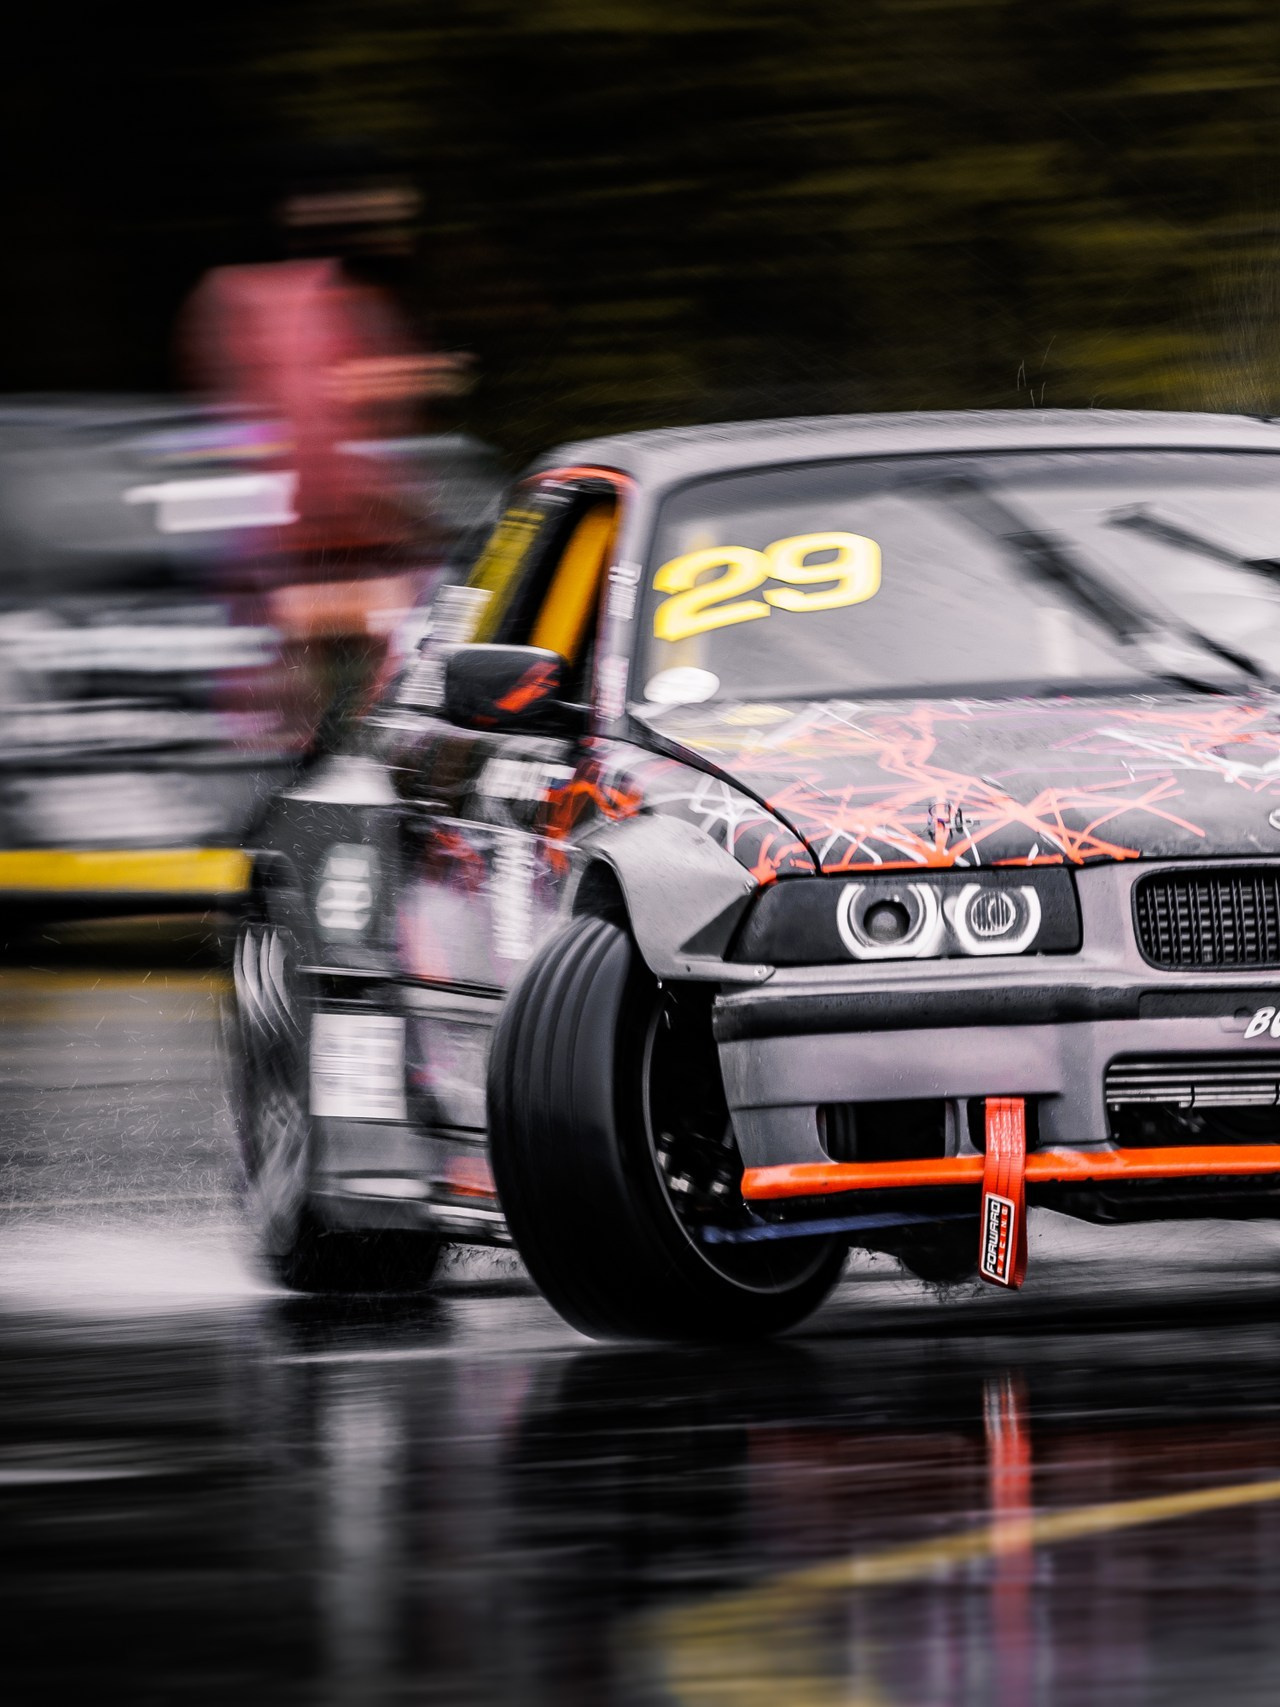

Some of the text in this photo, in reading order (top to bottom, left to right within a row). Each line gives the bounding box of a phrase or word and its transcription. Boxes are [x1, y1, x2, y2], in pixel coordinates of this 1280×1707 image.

[652, 531, 882, 642] 29
[986, 1200, 1001, 1273] FORWARD
[996, 1205, 1008, 1274] RACING
